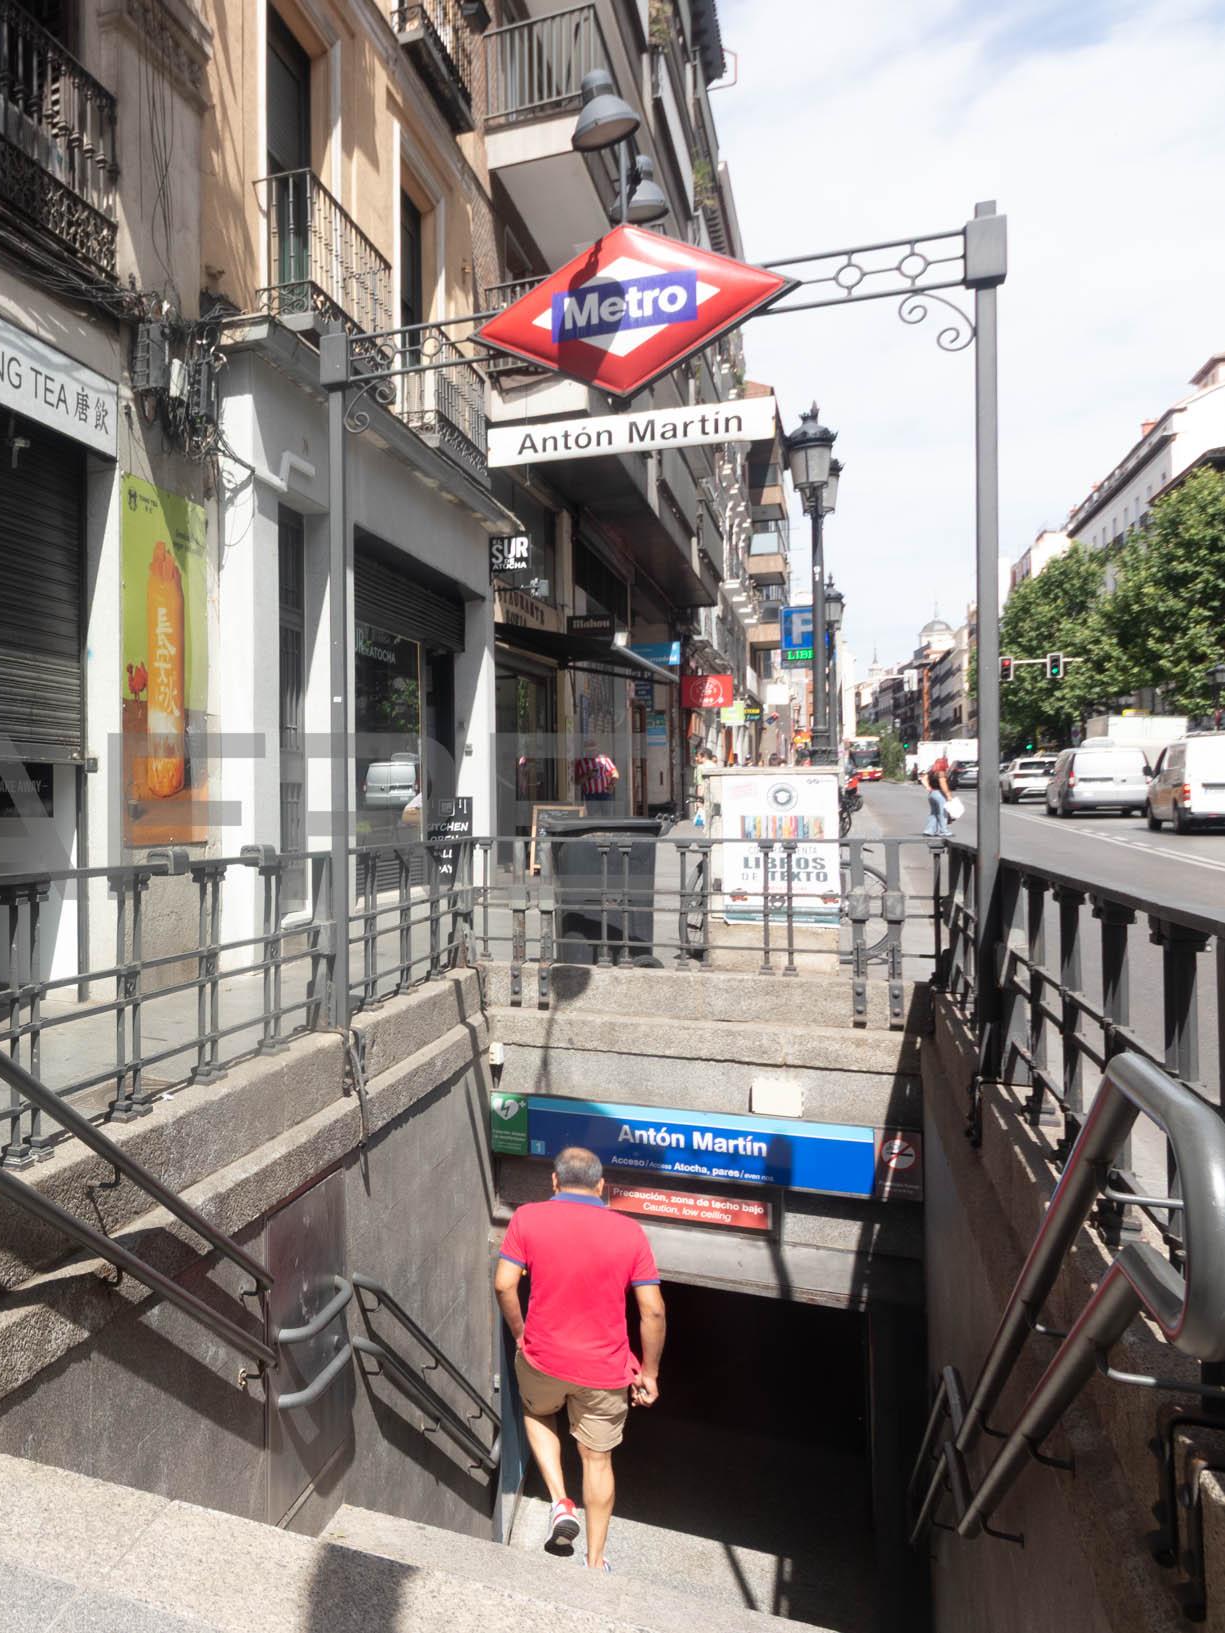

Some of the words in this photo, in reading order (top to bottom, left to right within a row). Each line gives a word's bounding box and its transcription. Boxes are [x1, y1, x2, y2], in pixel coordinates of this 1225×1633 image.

[563, 284, 688, 331] Metro
[30, 366, 69, 415] TEA
[516, 424, 614, 457] Antón
[628, 410, 743, 445] Martín
[491, 536, 529, 564] SUR
[492, 561, 527, 570] ATOCHA
[787, 649, 813, 661] LIB
[743, 856, 826, 871] LIBROS
[618, 1124, 685, 1149] Antón
[692, 1131, 768, 1157] Martín
[673, 1162, 710, 1175] Atocha,
[613, 1187, 669, 1203] Precaución,
[670, 1195, 695, 1206] zona
[696, 1196, 710, 1207] de
[712, 1198, 739, 1211] techo
[741, 1202, 765, 1215] bajo
[643, 1201, 680, 1215] Caution,
[682, 1205, 700, 1217] low
[700, 1209, 732, 1222] ceiling
